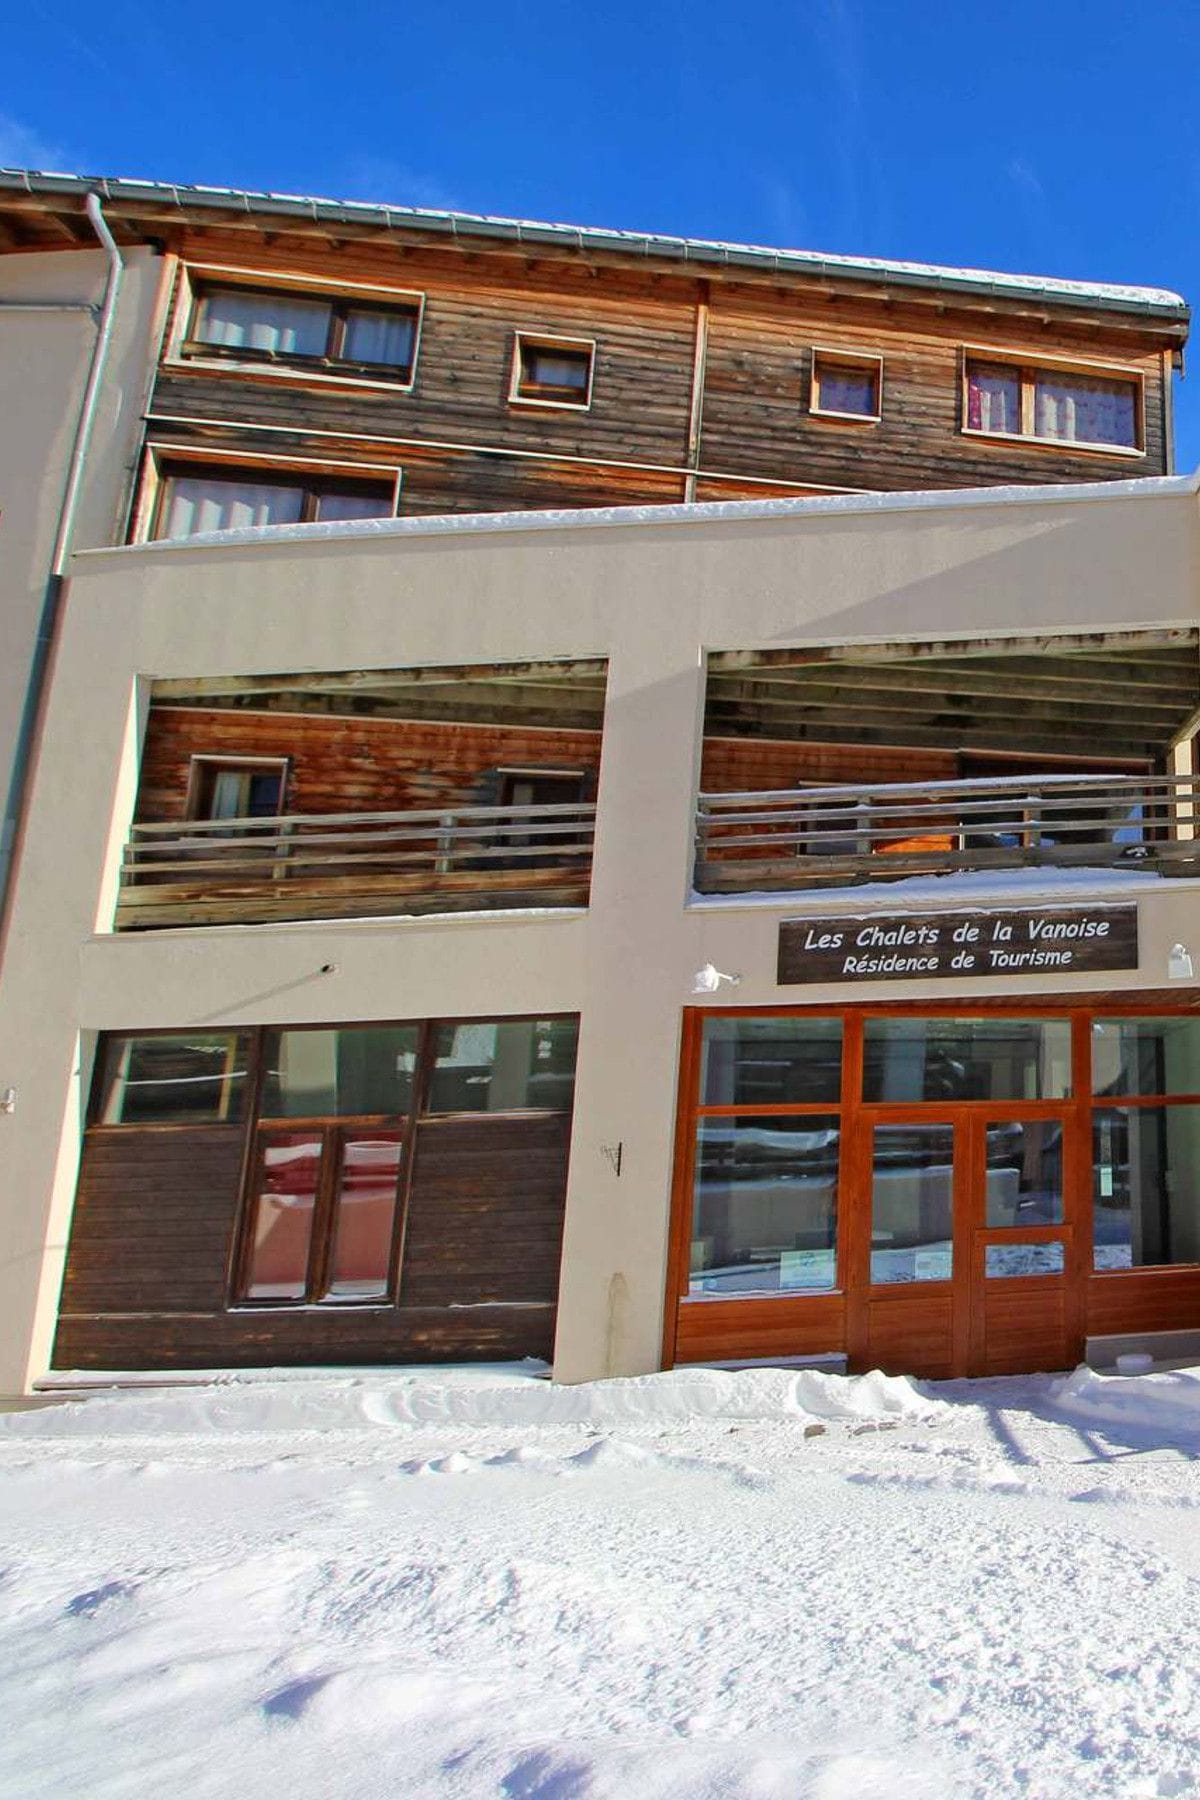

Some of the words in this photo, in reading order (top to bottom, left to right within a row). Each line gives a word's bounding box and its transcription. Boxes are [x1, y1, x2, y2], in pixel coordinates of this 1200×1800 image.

[804, 929, 844, 950] Les
[856, 924, 940, 947] Chalets
[952, 922, 980, 943] de
[992, 920, 1013, 941] la
[1028, 919, 1110, 940] Vanoise
[842, 953, 939, 974] Résidence
[950, 950, 975, 969] de
[989, 950, 1073, 968] Tourisme
